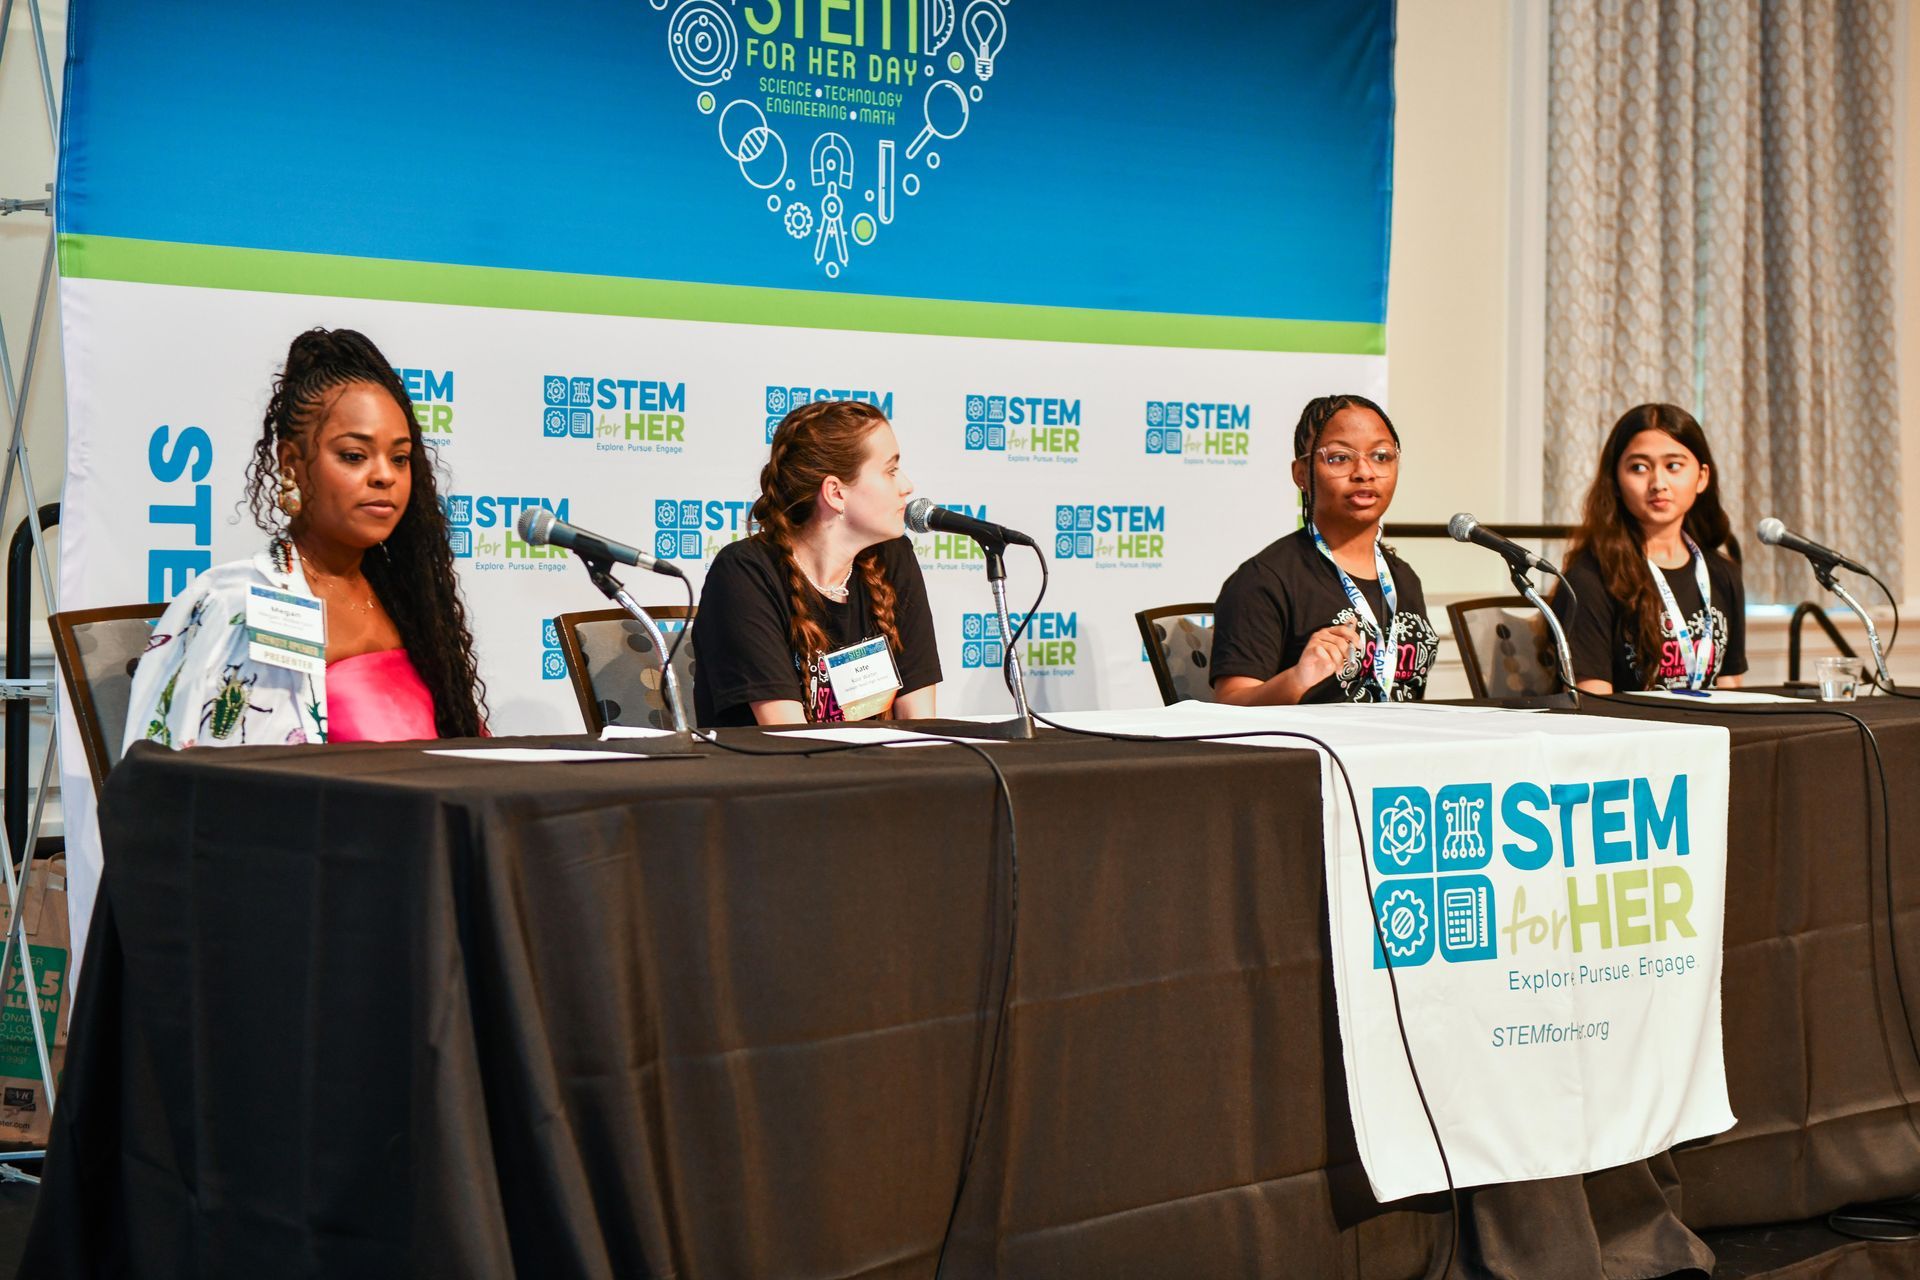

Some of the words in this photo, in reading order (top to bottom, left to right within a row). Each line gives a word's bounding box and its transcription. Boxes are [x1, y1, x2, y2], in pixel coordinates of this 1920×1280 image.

[746, 38, 796, 72] FOR
[808, 46, 857, 80] HER
[869, 55, 918, 86] DAY
[759, 77, 812, 98] SCIENCE
[824, 84, 903, 107] TECHNOLOGY
[766, 97, 847, 121] ENGINEERING
[859, 109, 896, 126] MATH
[392, 368, 454, 402] EM
[596, 378, 686, 413] STEM
[412, 404, 454, 434] ER
[1008, 396, 1081, 426] STEM
[1185, 402, 1250, 430] STEM
[595, 417, 621, 438] for
[624, 413, 685, 442] HER
[1007, 428, 1028, 450] for
[1031, 427, 1080, 453] HER
[1184, 432, 1201, 454] for
[1205, 431, 1249, 455] HER
[148, 424, 213, 604] STE
[705, 500, 760, 531] STE
[1096, 505, 1165, 533] STEM
[474, 532, 501, 557] for
[1095, 536, 1114, 557] for
[1117, 534, 1164, 559] HER
[1008, 611, 1077, 640] STEM
[1027, 640, 1077, 666] HER
[854, 664, 870, 674] Kate
[1501, 774, 1690, 871] STEM
[1501, 885, 1567, 955] for
[1566, 865, 1698, 953] HER
[14, 954, 44, 966] OER
[2, 1012, 46, 1025] ONAT
